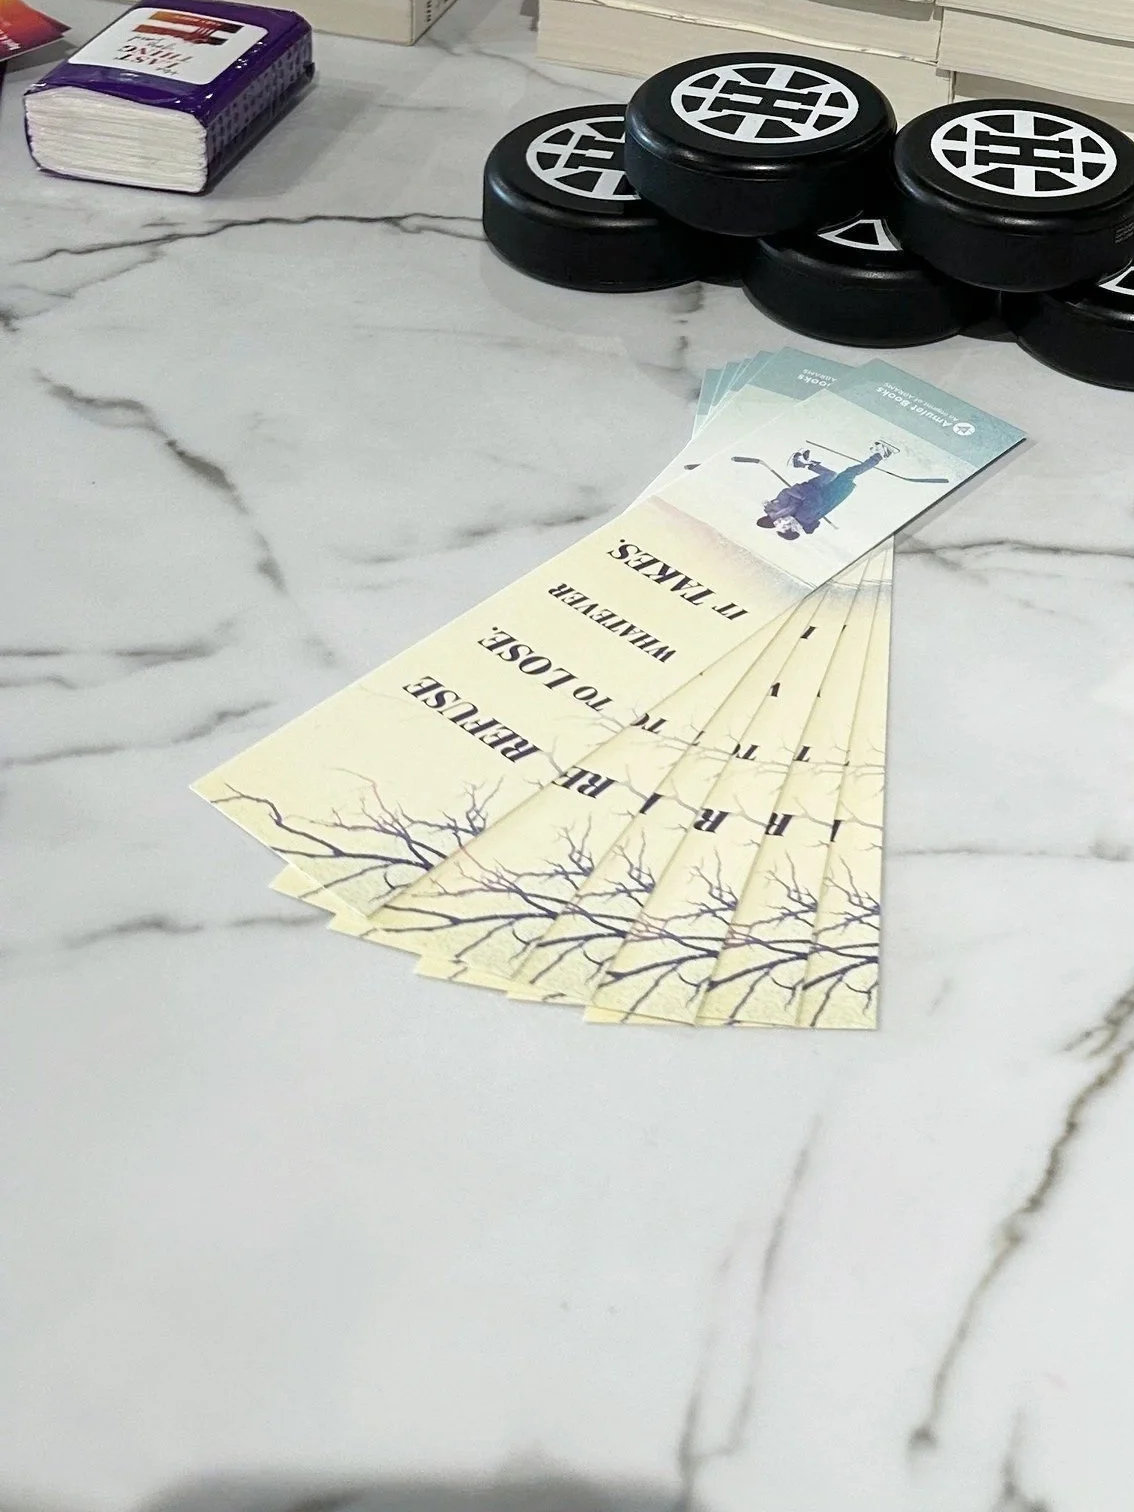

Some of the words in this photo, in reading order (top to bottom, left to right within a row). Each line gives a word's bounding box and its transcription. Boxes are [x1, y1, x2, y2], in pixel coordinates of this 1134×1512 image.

[875, 385, 911, 408] Books
[910, 405, 955, 429] Amulet
[607, 539, 715, 607] TAKES.
[547, 583, 677, 664] WHATEVER
[712, 602, 749, 621] IT
[477, 626, 578, 690] LOSE.
[402, 675, 540, 764] REFUSE
[572, 685, 613, 712] TO
